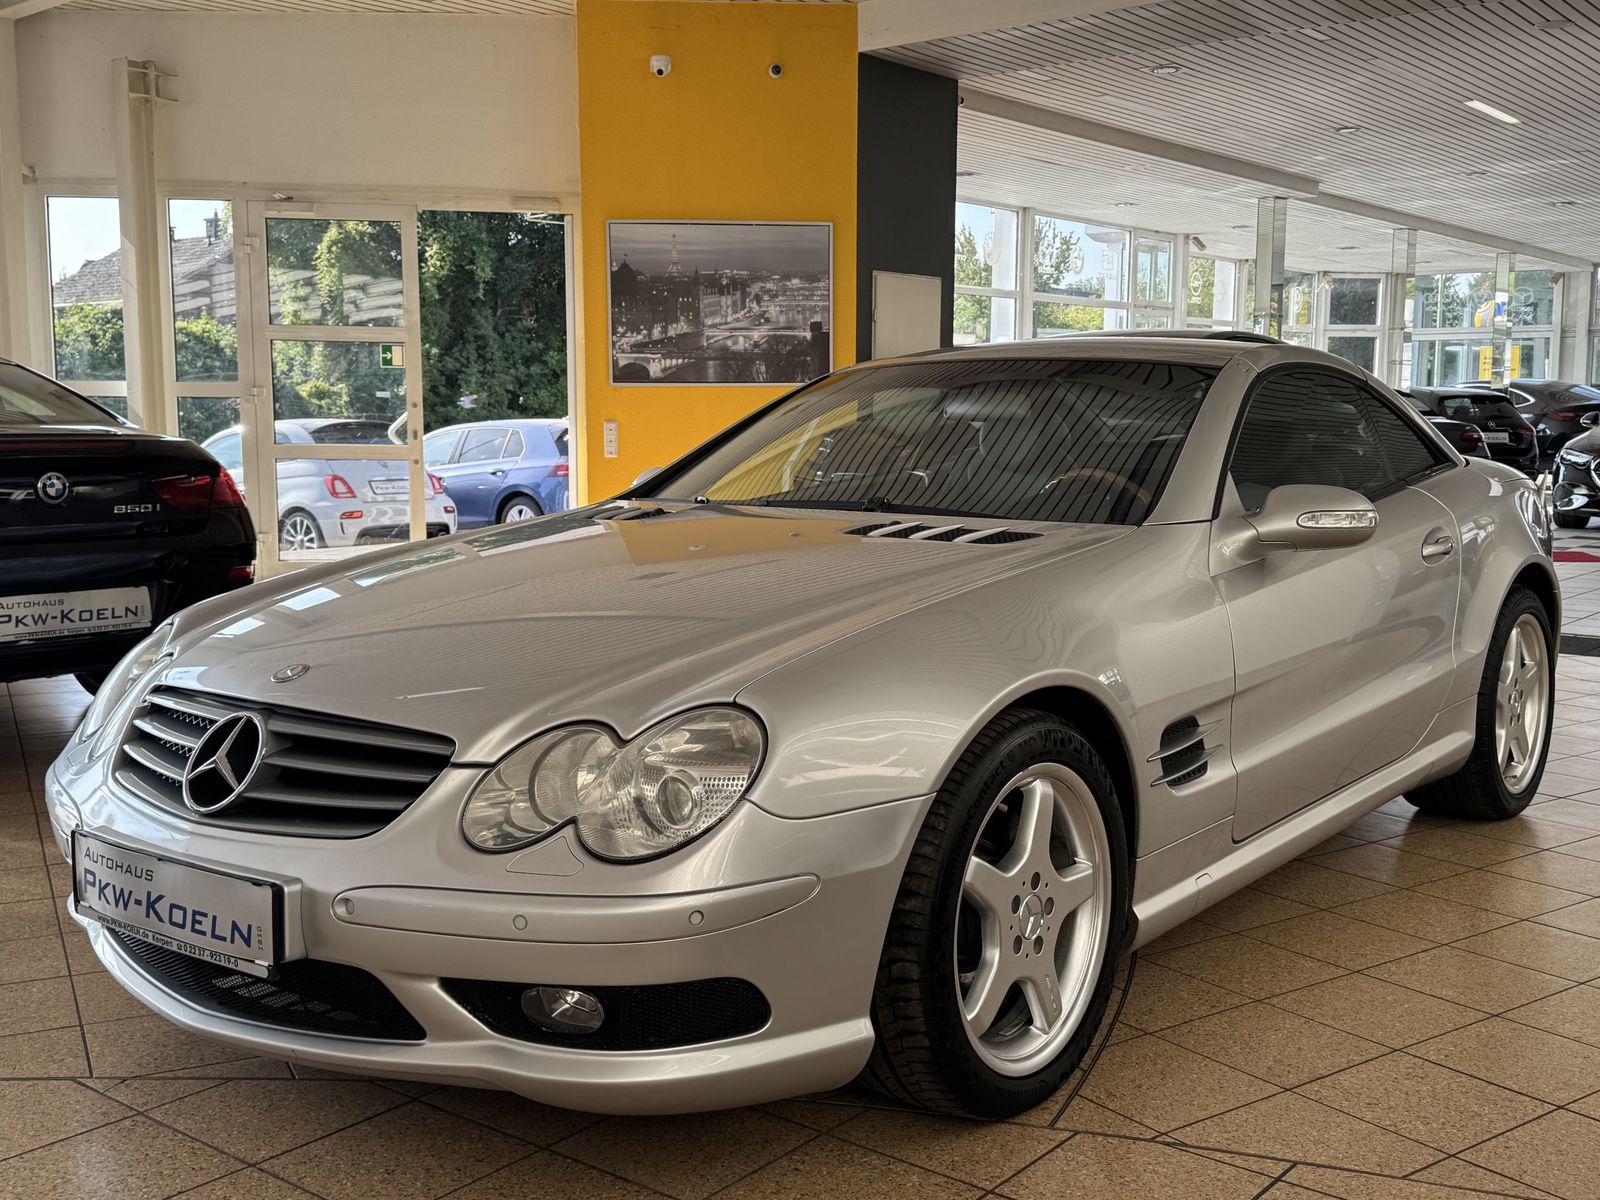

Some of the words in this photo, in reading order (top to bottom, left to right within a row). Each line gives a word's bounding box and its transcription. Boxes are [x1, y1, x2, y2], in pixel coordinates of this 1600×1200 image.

[0, 599, 65, 610] AUTOHAUS
[84, 846, 154, 882] AUTOHAUS
[83, 867, 253, 948] PKW-KOELN
[152, 933, 173, 948] Kerpen
